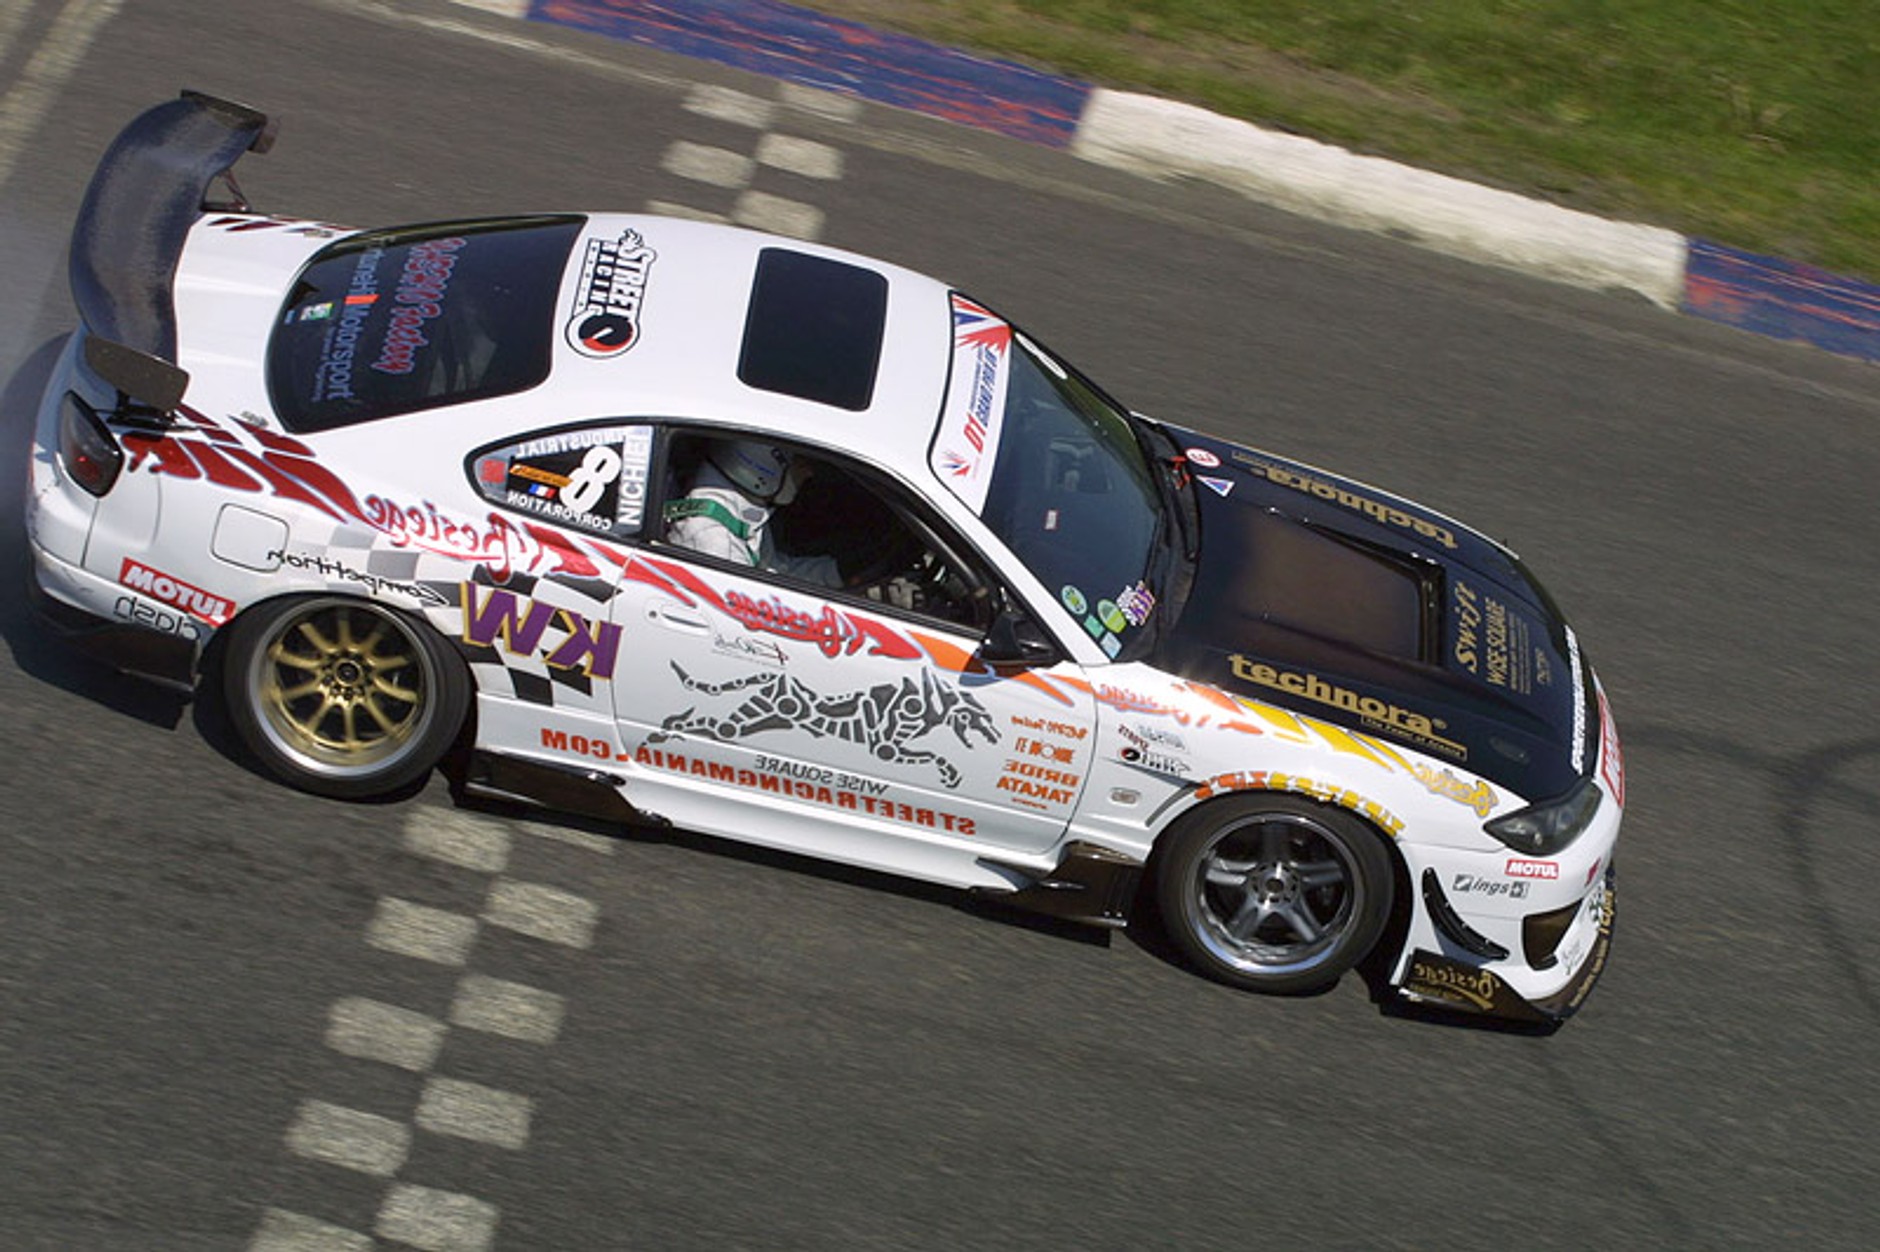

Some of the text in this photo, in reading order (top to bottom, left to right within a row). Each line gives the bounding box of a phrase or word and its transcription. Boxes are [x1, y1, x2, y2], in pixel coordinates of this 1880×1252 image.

[588, 240, 619, 316] RACING
[607, 243, 656, 320] STREET
[559, 445, 622, 514] 8
[124, 562, 231, 623] MOTUL
[1454, 582, 1481, 674] Swift
[1507, 859, 1558, 878] MOTUL
